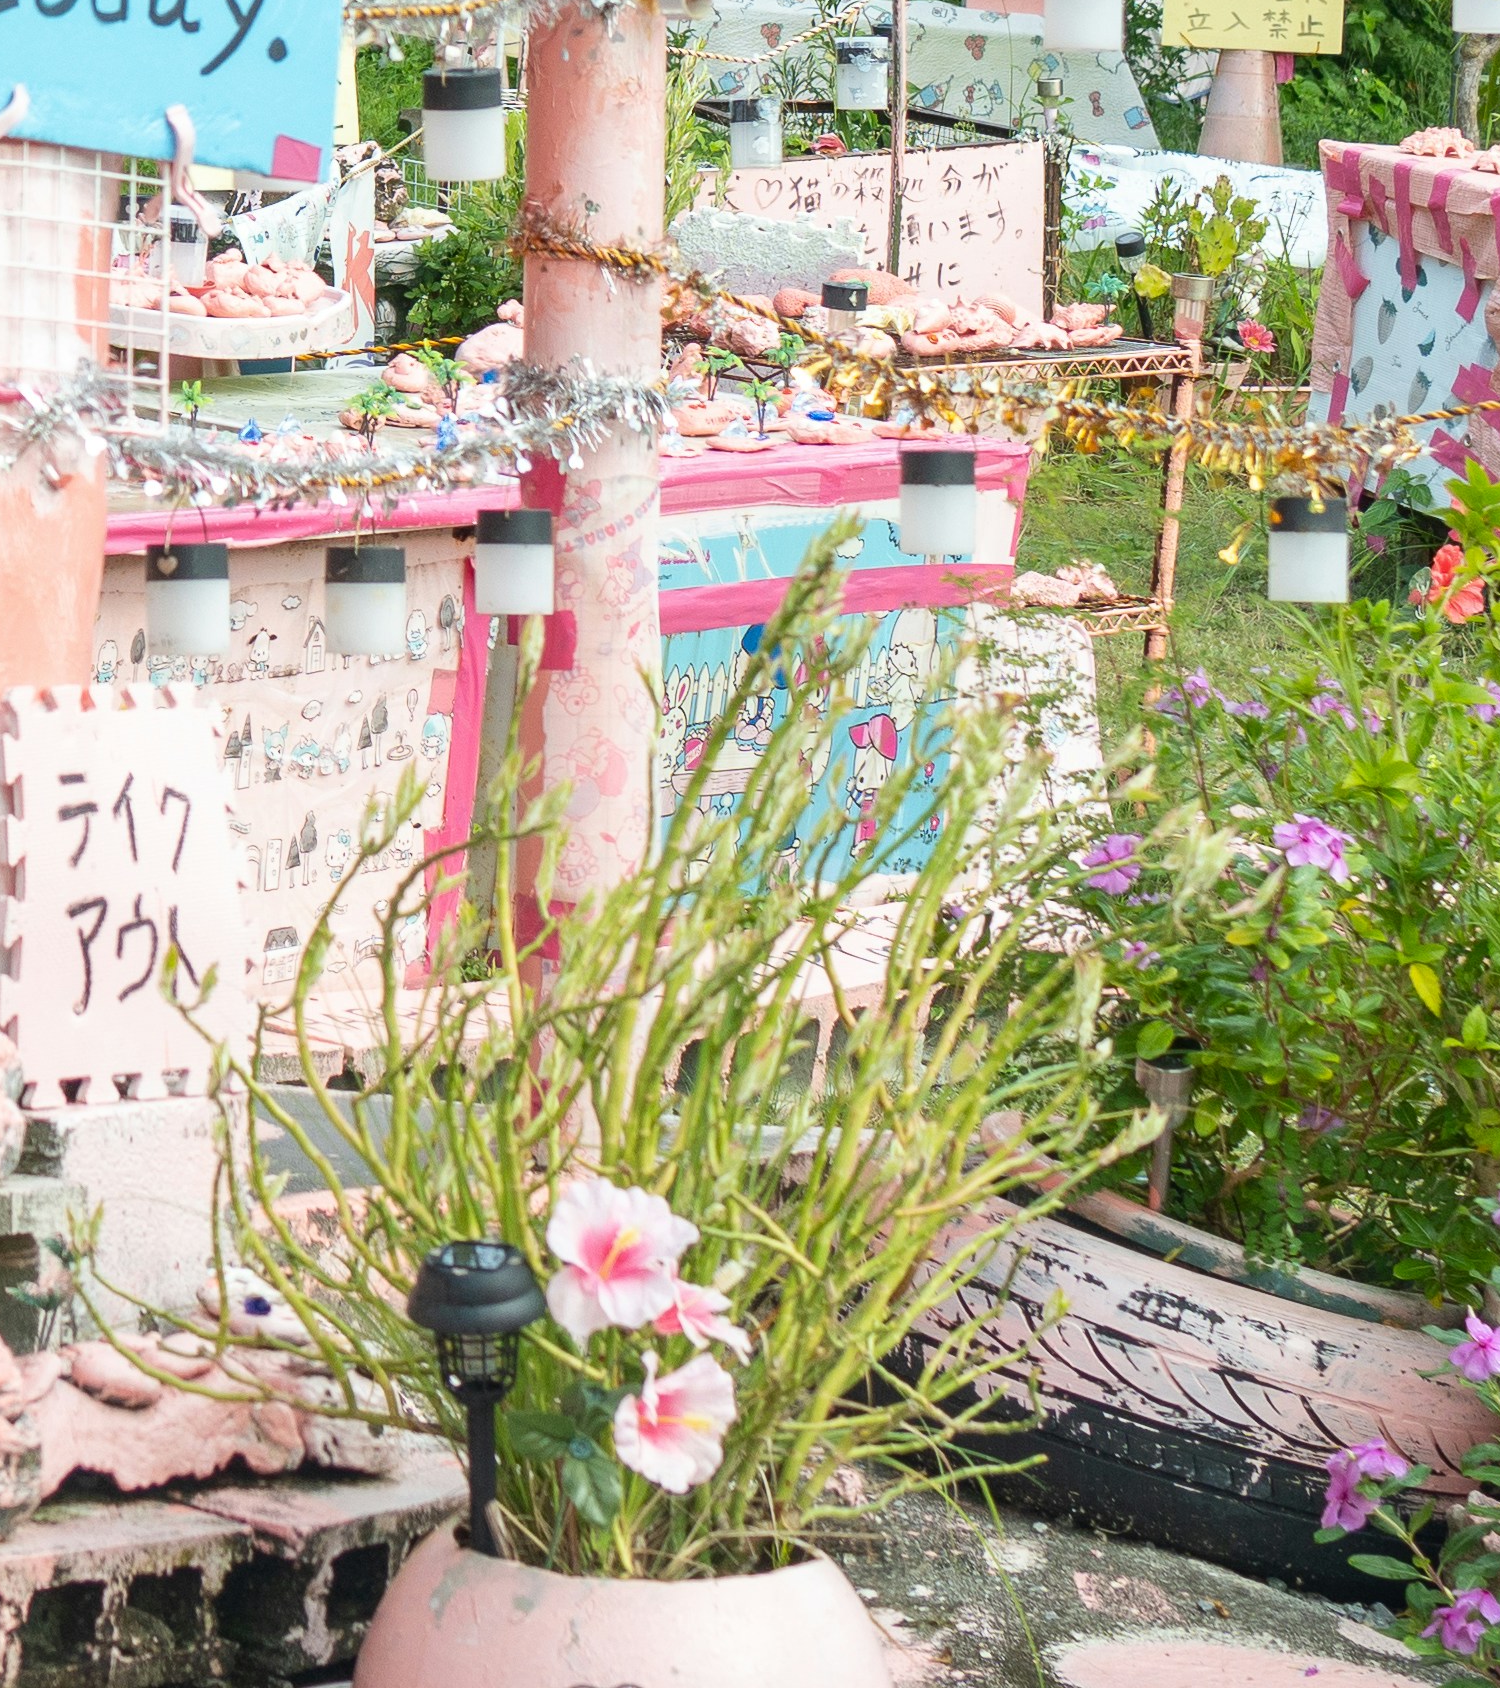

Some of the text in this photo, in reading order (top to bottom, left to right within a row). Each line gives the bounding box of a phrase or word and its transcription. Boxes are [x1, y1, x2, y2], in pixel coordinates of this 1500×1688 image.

[1187, 7, 1326, 40] 立入禁止
[57, 772, 192, 875] テイク
[66, 892, 202, 1016] アウト
